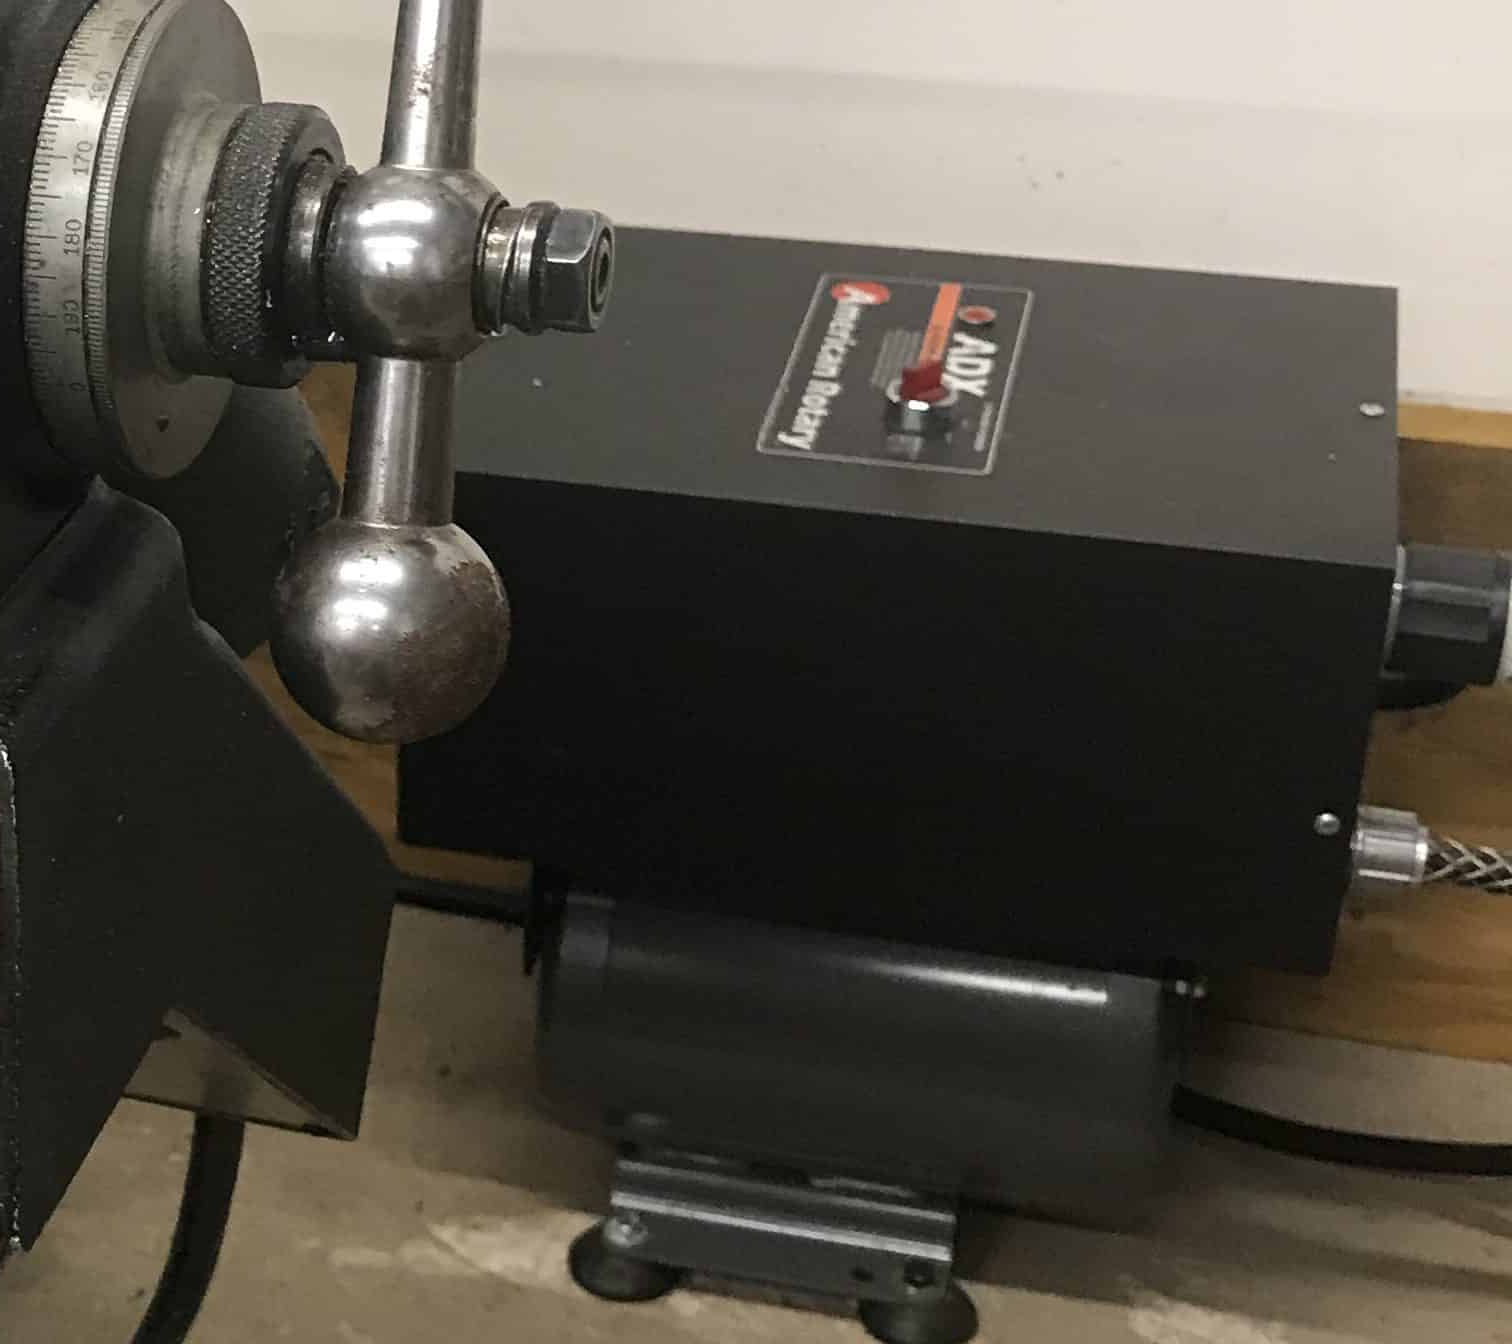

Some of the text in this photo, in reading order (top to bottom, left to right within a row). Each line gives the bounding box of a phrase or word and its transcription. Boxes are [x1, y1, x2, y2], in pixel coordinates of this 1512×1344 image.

[72, 140, 94, 177] 170
[63, 218, 82, 257] 180
[777, 283, 882, 450] American Rotary
[942, 332, 999, 397] ADX
